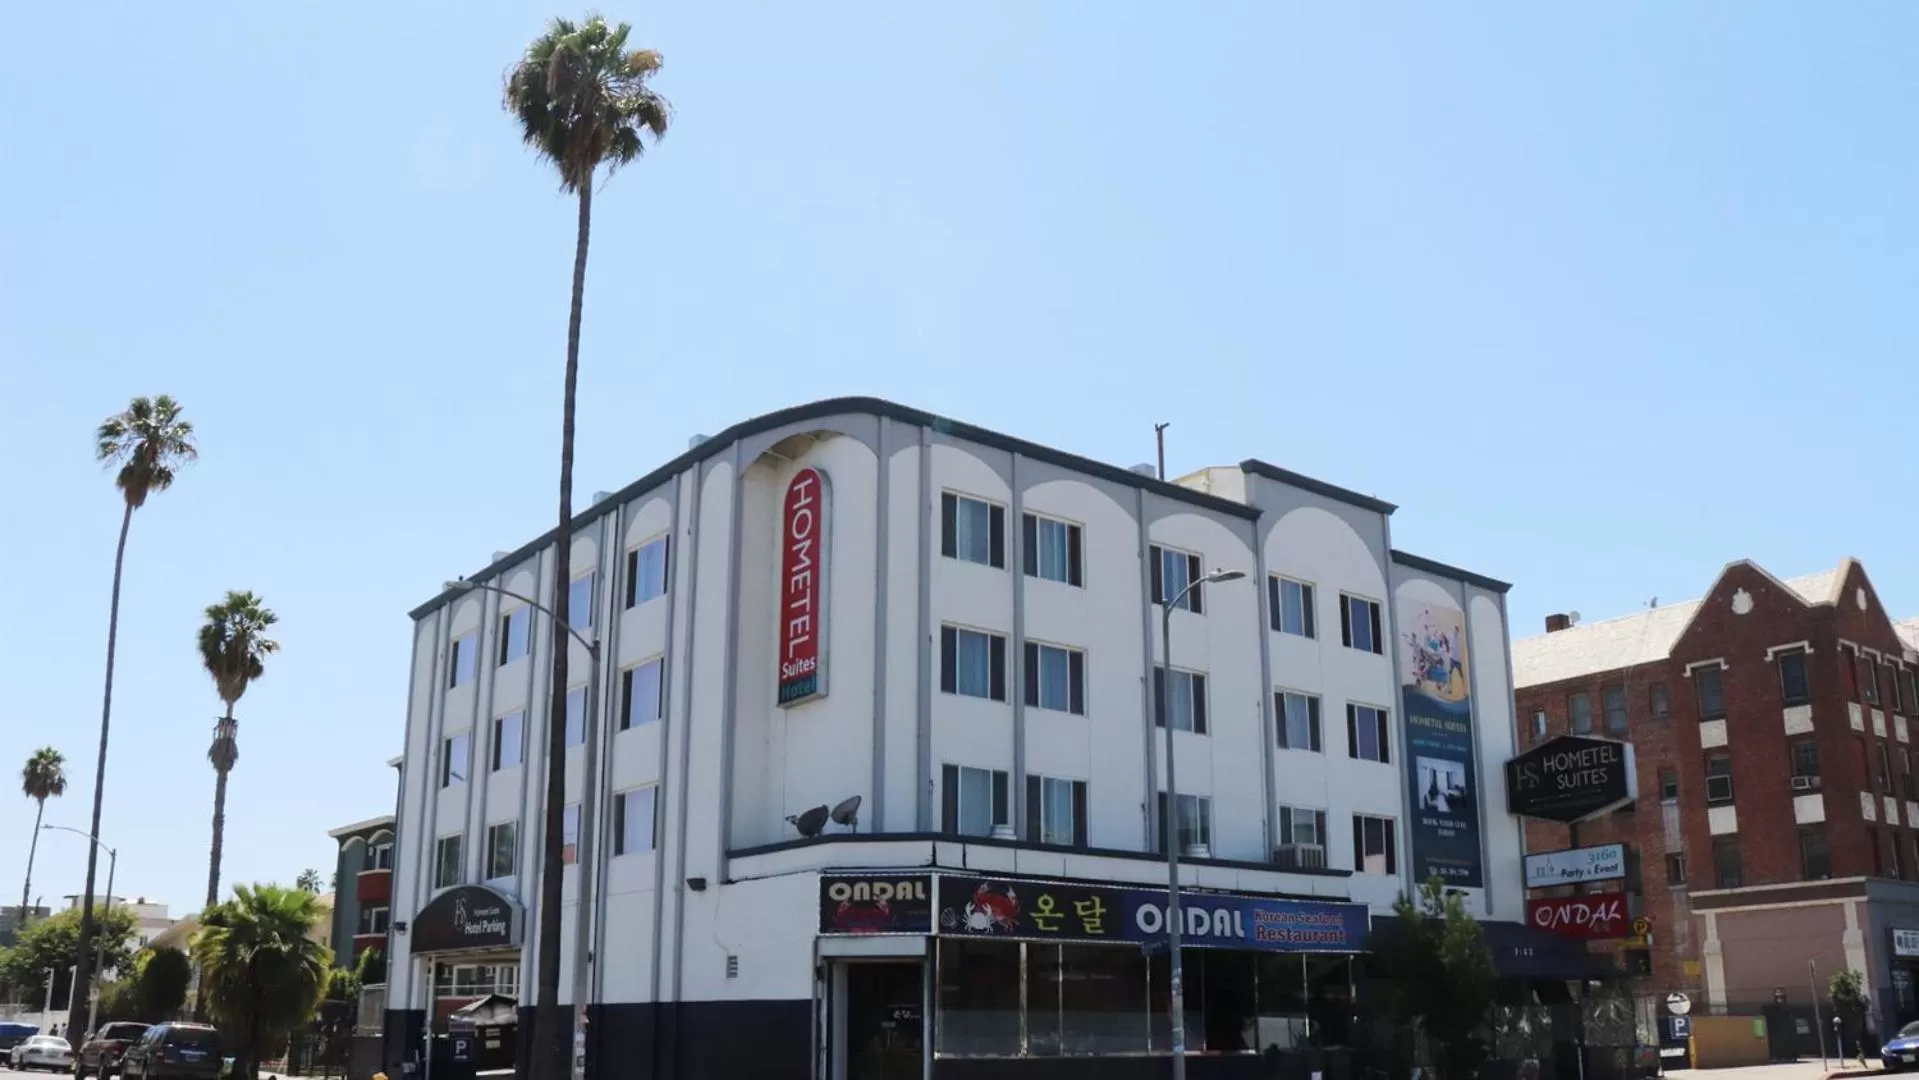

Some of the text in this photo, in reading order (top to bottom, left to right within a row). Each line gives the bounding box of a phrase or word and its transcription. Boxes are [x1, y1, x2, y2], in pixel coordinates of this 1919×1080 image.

[788, 478, 814, 658] HOMETEL
[781, 656, 816, 679] Suites
[780, 676, 816, 700] Hotel
[1543, 745, 1618, 774] HOMETEL
[1557, 768, 1608, 790] SUITES
[1561, 868, 1585, 880] Party
[1594, 864, 1619, 875] Event
[828, 881, 926, 901] ONDAL
[1254, 908, 1297, 924] Korean
[1535, 900, 1622, 929] ONDAL
[1255, 923, 1347, 944] Restaurant
[1674, 1017, 1686, 1033] P
[455, 1040, 467, 1054] P
